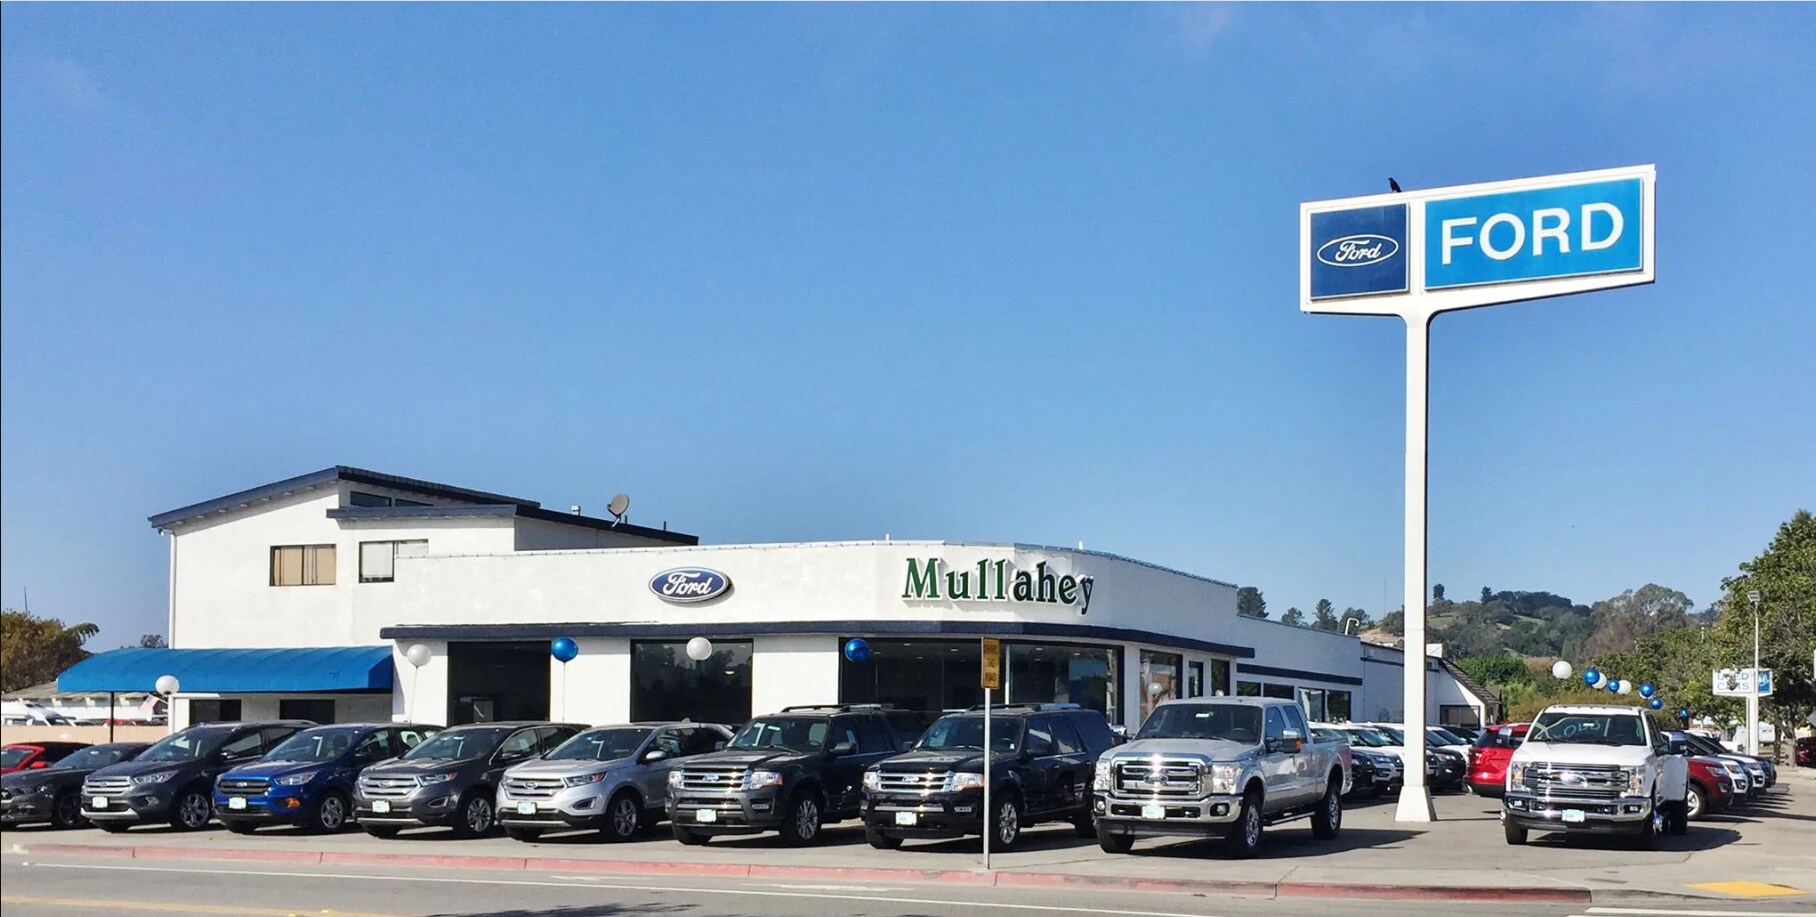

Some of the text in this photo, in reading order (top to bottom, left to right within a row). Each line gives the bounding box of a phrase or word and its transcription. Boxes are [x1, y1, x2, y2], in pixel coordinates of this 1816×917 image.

[1442, 202, 1624, 265] FORD
[1335, 239, 1382, 263] Ford
[662, 572, 713, 595] Ford
[901, 557, 1094, 615] Mullahey
[1717, 672, 1750, 681] UED
